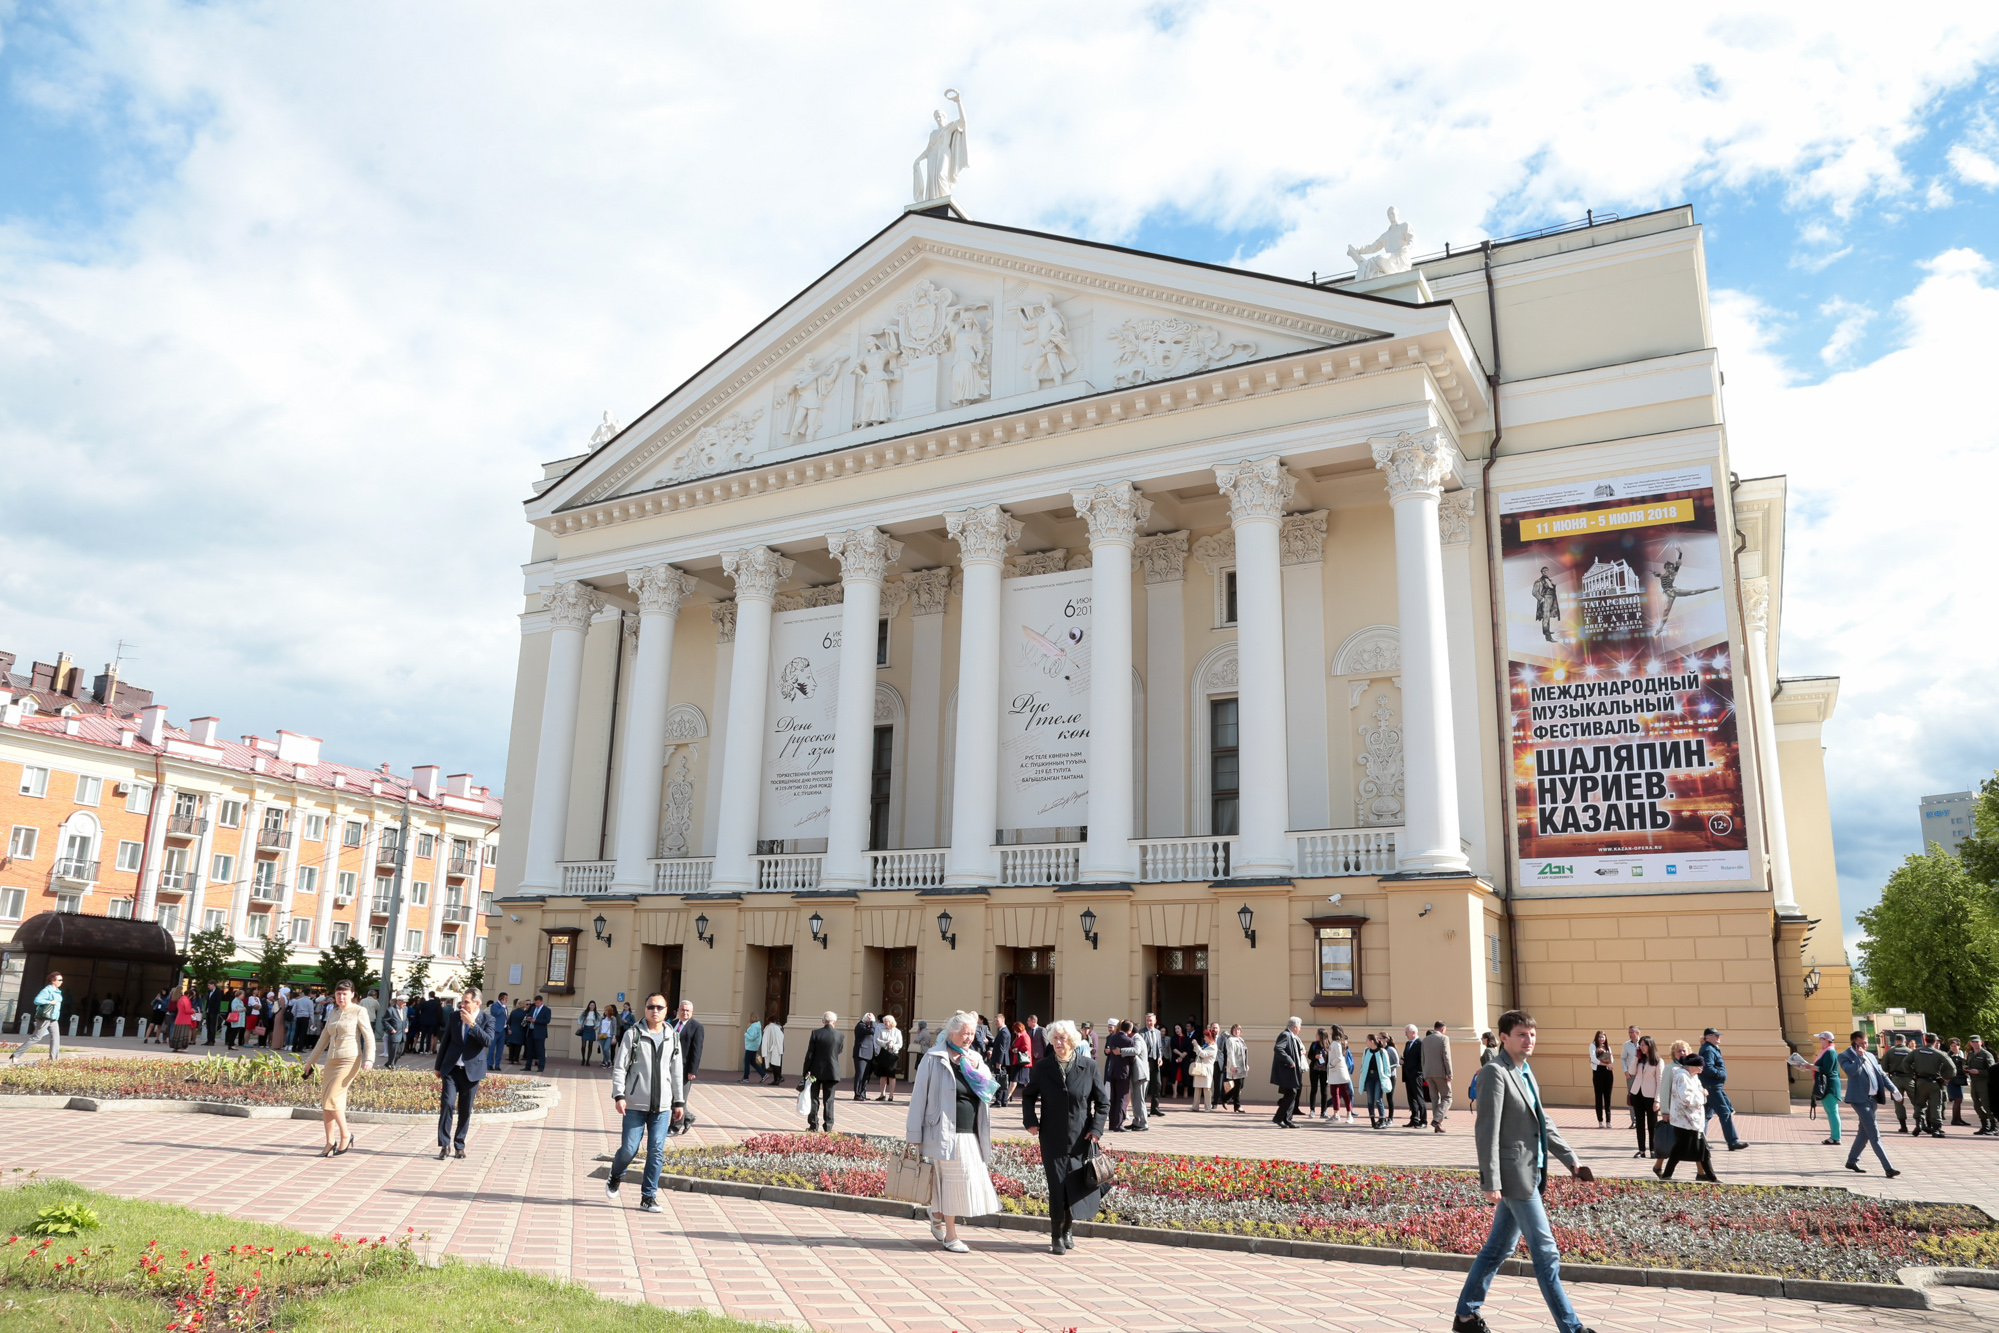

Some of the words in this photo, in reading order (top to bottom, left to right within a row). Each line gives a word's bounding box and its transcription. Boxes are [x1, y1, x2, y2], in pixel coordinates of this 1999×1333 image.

[1535, 522, 1549, 534] 11
[1552, 517, 1587, 532] ИЮНЯ
[1598, 515, 1606, 526] 5
[1608, 510, 1645, 525] ИЮЛЯ
[1647, 506, 1677, 520] 2018
[1064, 598, 1075, 617] 6
[1583, 594, 1640, 608] ТАТАРСКИЙ
[1616, 619, 1642, 627] БАЛЕТА
[822, 631, 832, 649] 6
[1531, 670, 1700, 702] МЕЖДУНАРОДНЫЙ
[1008, 691, 1051, 731] Рус
[1532, 692, 1675, 721] МУЗЫКАЛЬНЫЙ
[774, 715, 813, 733] День
[1035, 713, 1082, 726] теле
[1533, 719, 1641, 740] ФЕСТИВАЛЬ
[1535, 739, 1714, 777] ШАЛЯПИН.
[1537, 772, 1675, 806] НУРИЕВ.
[1539, 802, 1671, 835] КАЗАНЬ
[1713, 820, 1728, 830] 12+
